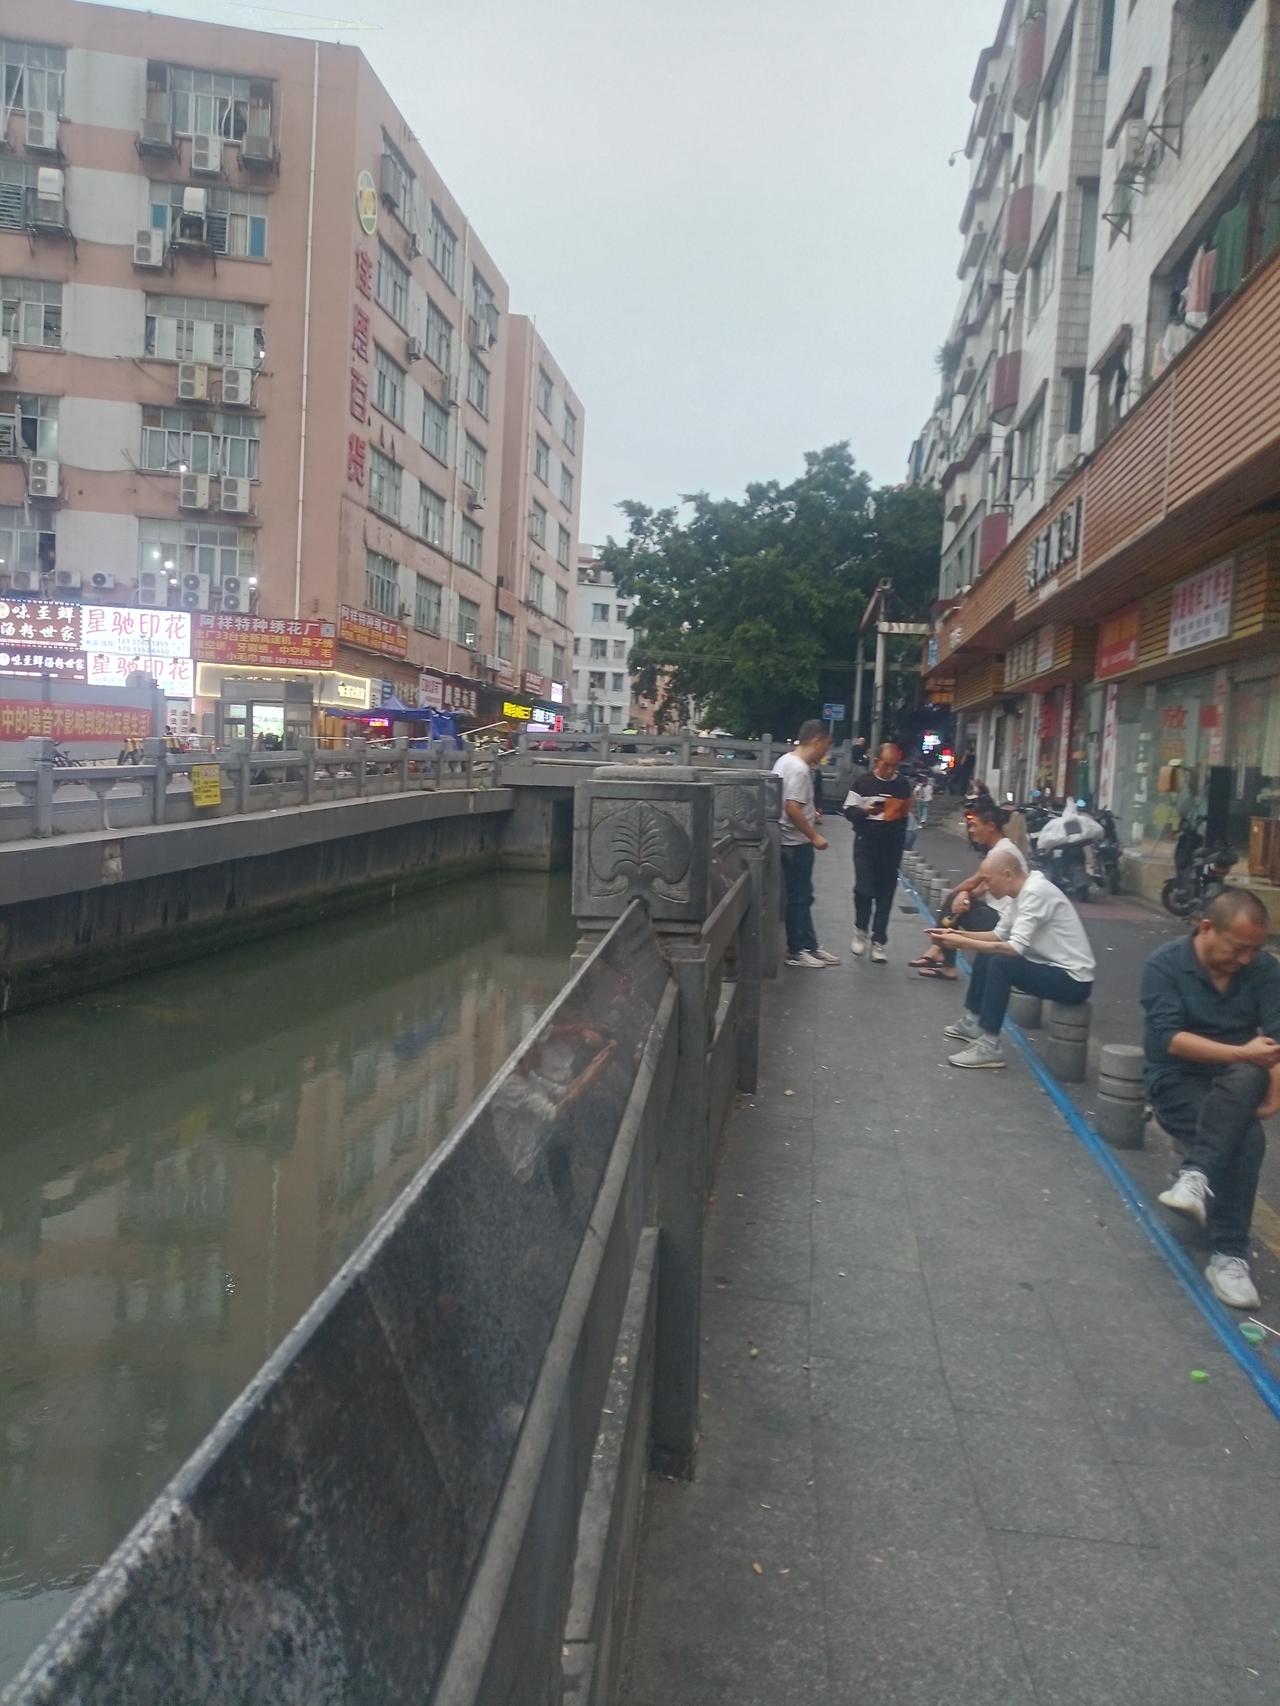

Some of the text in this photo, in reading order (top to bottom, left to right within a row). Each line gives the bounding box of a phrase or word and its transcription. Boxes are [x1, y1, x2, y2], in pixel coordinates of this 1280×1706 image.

[11, 603, 75, 623] 味至鲜
[86, 608, 186, 639] 星驰印花
[1, 622, 75, 641] 汤粉世家
[199, 614, 320, 635] 阿祥特种绣花厂
[92, 655, 190, 680] 星驰印花
